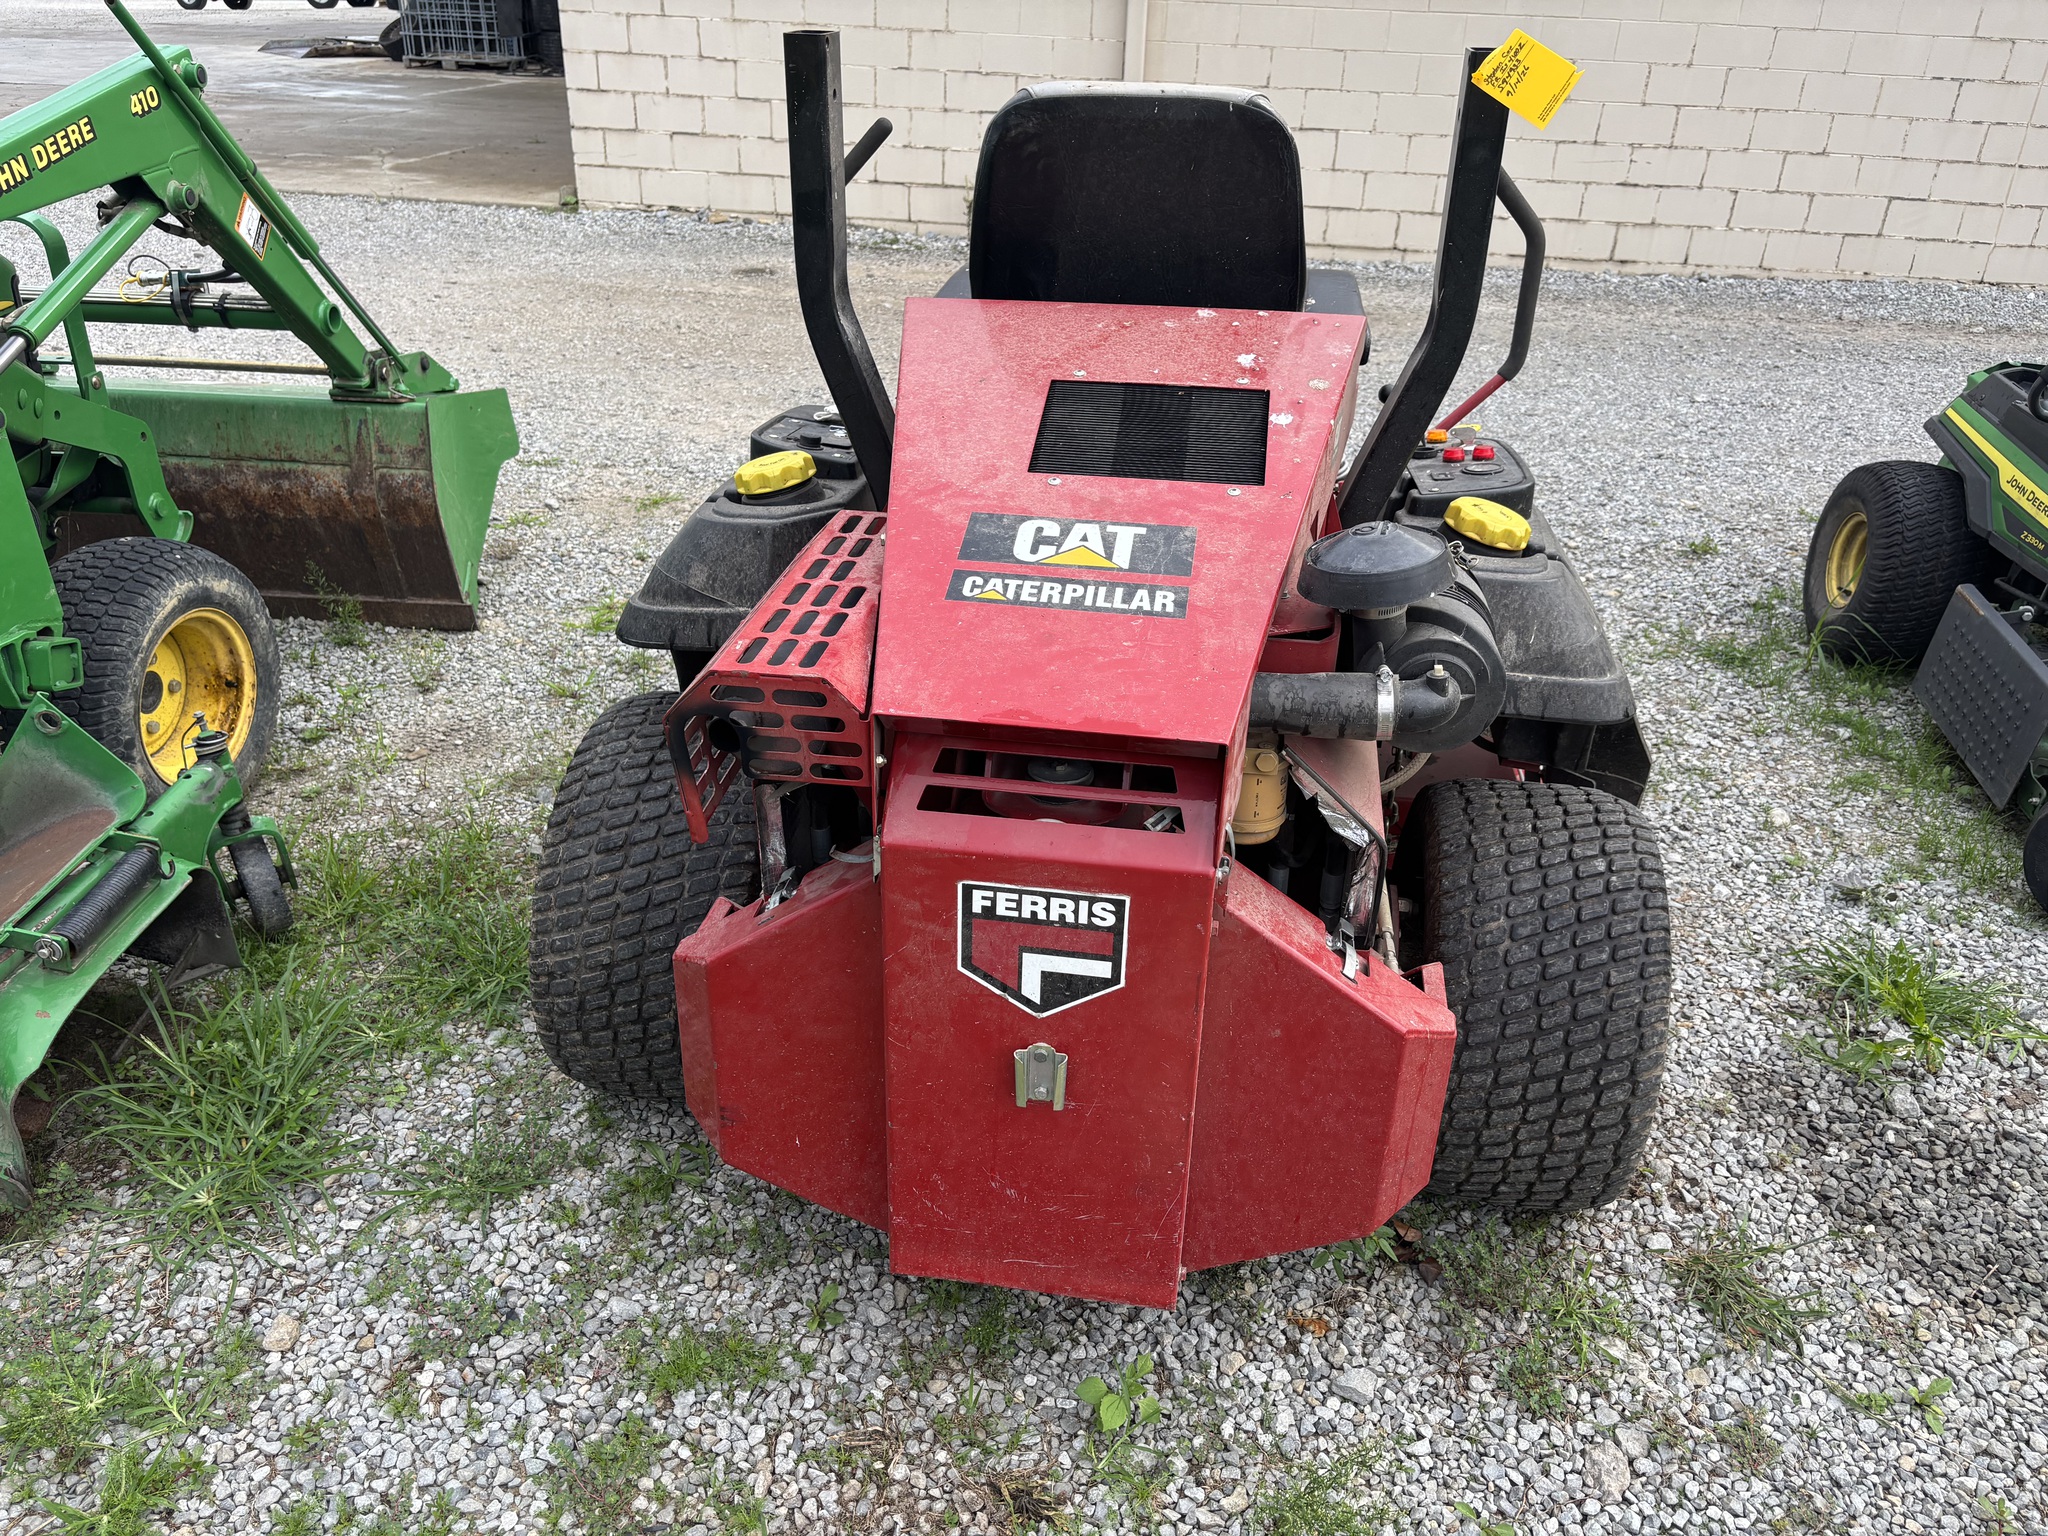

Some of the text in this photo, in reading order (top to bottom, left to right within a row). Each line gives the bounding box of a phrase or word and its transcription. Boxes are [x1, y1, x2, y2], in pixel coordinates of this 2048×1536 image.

[130, 85, 160, 117] 410
[0, 115, 96, 194] HN DEERE
[2006, 474, 2048, 517] JOHN DEER
[1012, 519, 1147, 570] CAT
[2020, 530, 2046, 551] Z330M
[961, 575, 1175, 613] CATERPILLAR
[971, 889, 1117, 927] FERRIS
